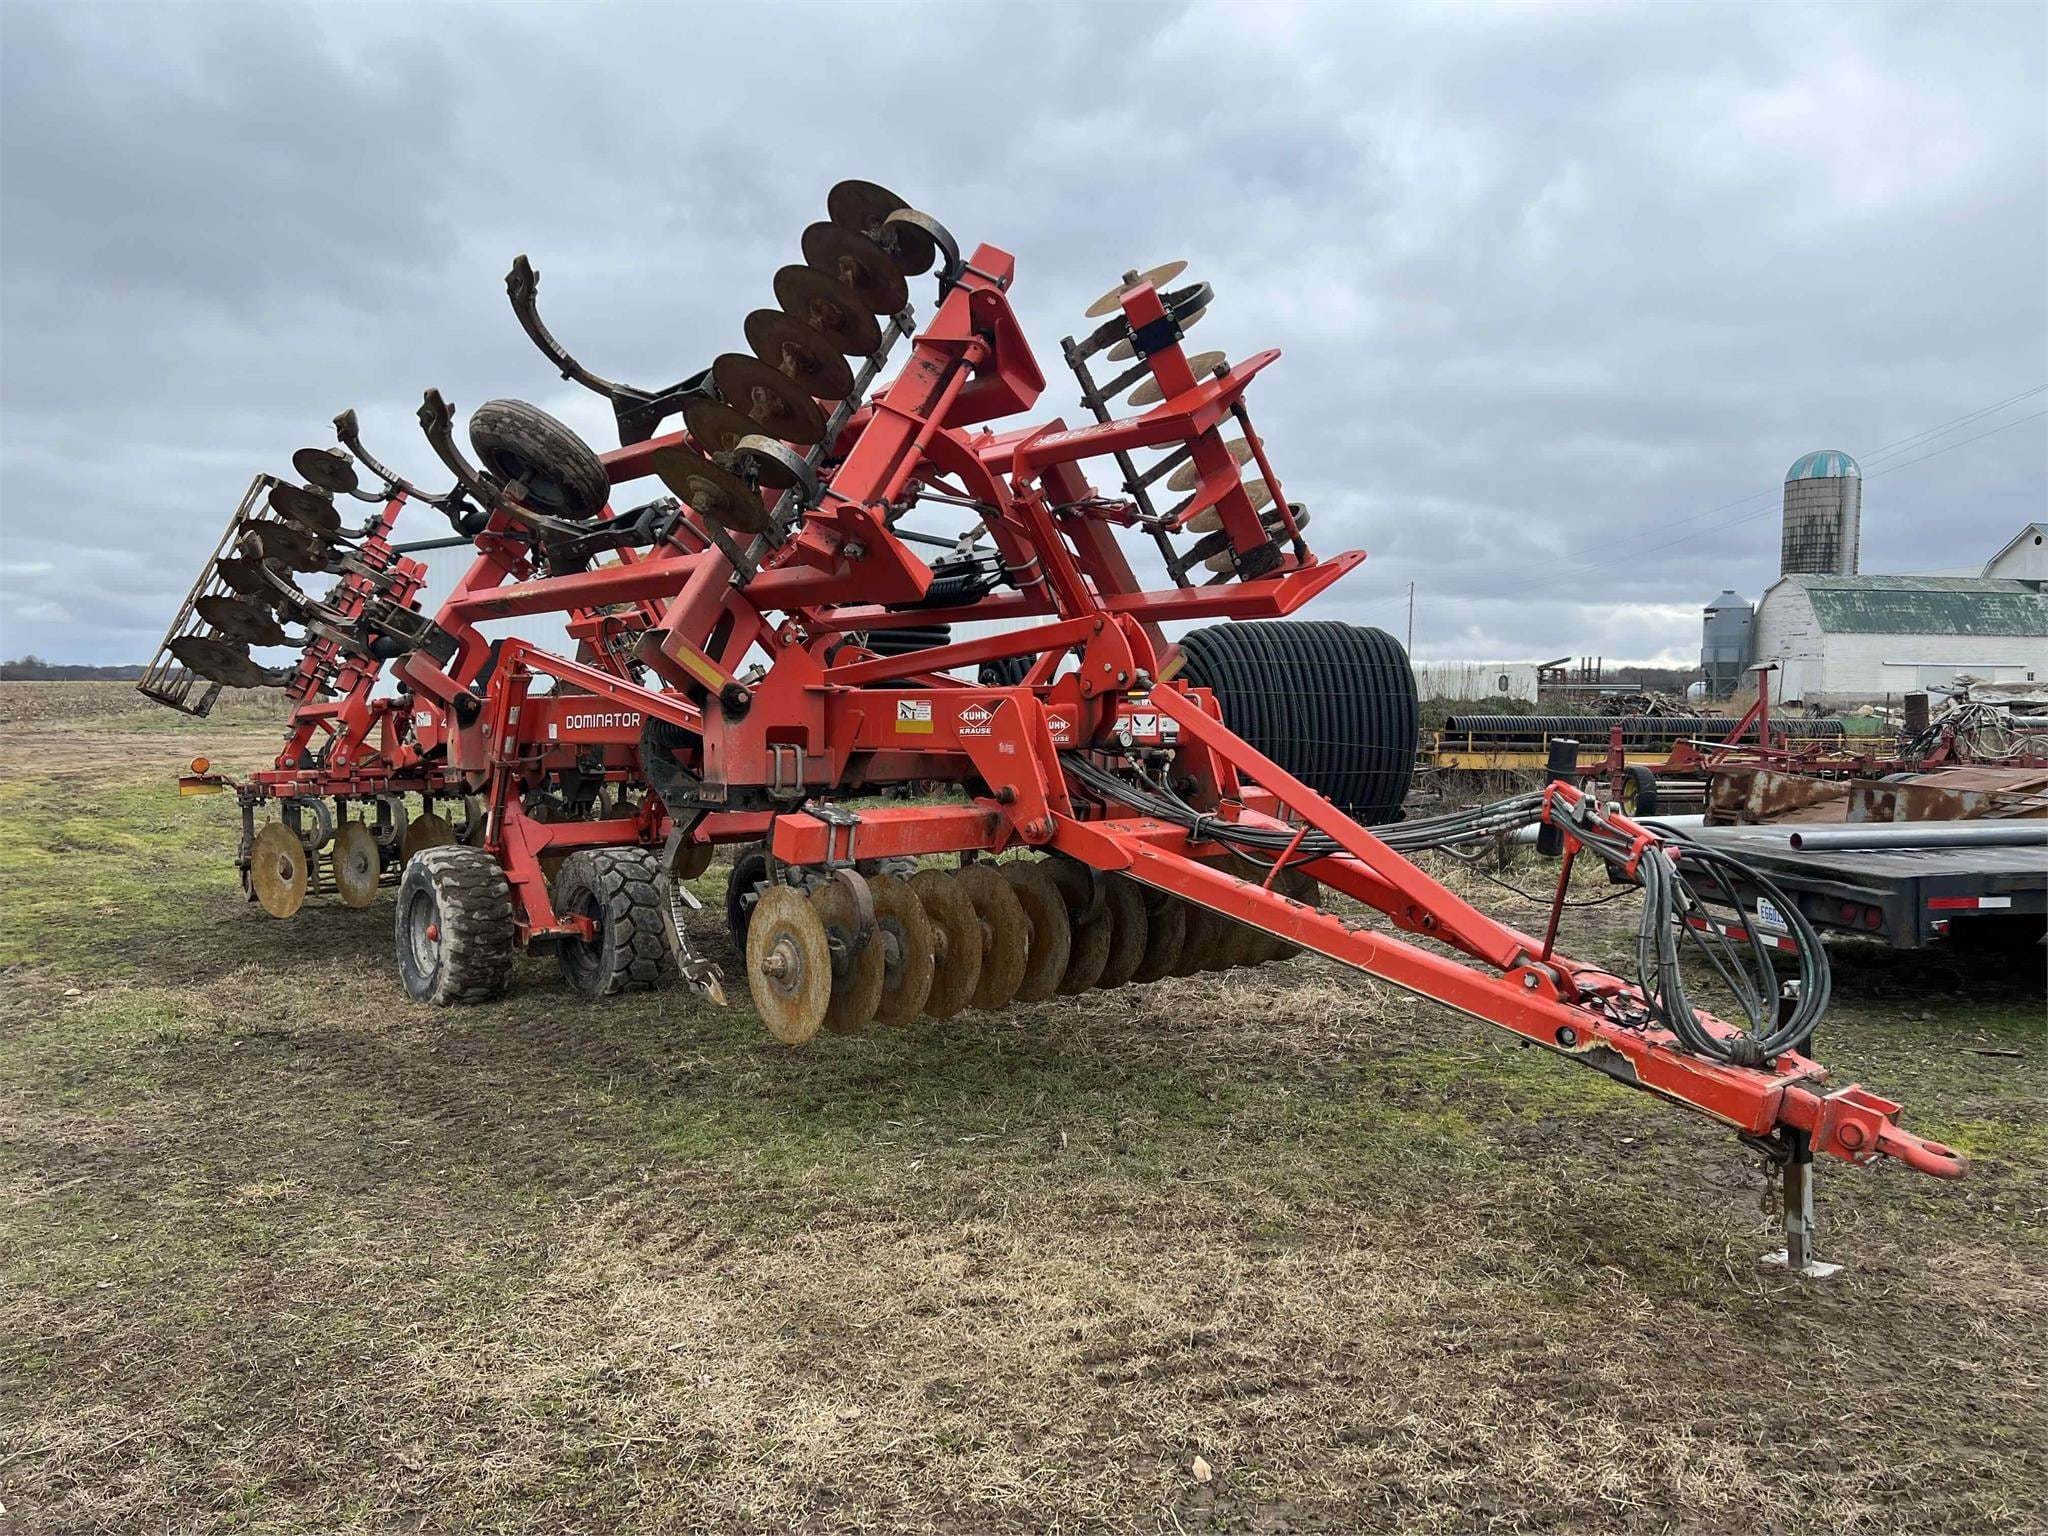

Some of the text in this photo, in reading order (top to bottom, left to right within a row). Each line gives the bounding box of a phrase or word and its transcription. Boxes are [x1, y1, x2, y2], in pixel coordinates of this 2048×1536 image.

[963, 711, 989, 720] KUHN
[565, 712, 640, 729] DOMINATOR
[1048, 721, 1067, 730] UHN
[959, 727, 992, 735] KRAUSE
[1760, 905, 1785, 923] E6601
